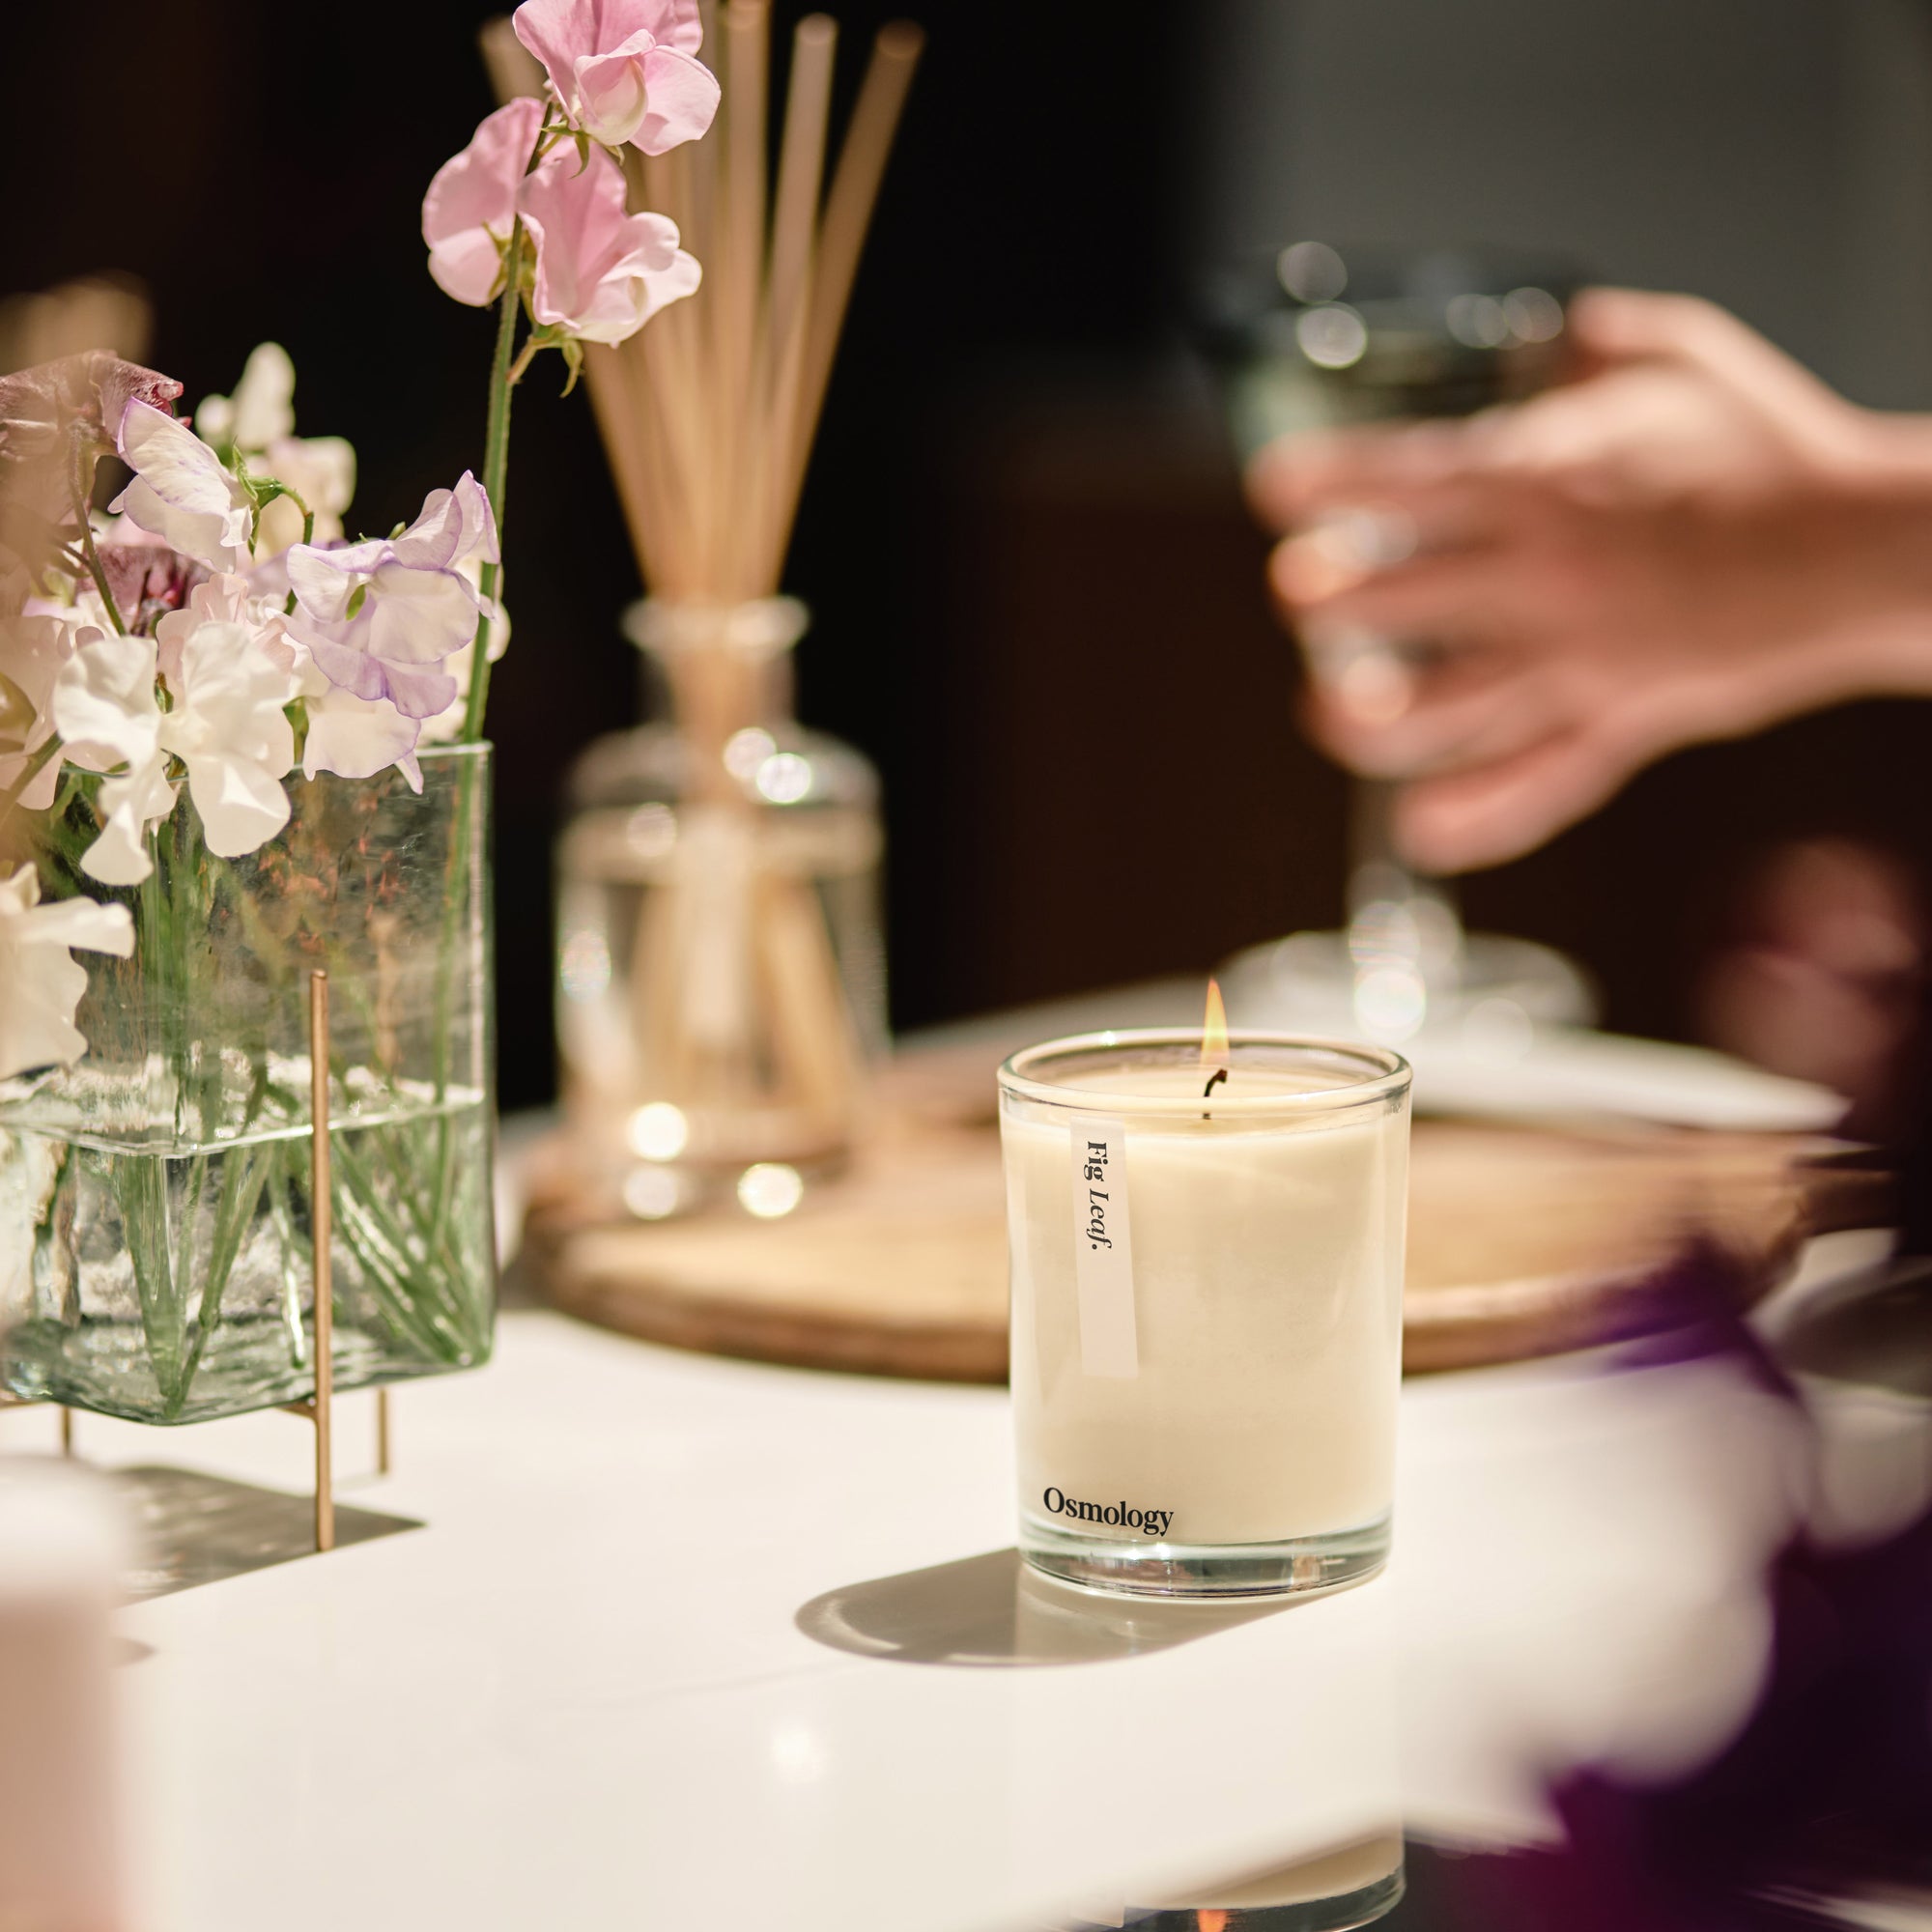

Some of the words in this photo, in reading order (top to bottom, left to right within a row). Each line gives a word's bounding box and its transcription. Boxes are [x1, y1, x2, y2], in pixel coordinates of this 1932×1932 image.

[1083, 1141, 1109, 1182] Fig
[1086, 1188, 1113, 1250] Leaf.
[1043, 1487, 1174, 1537] Osmology
